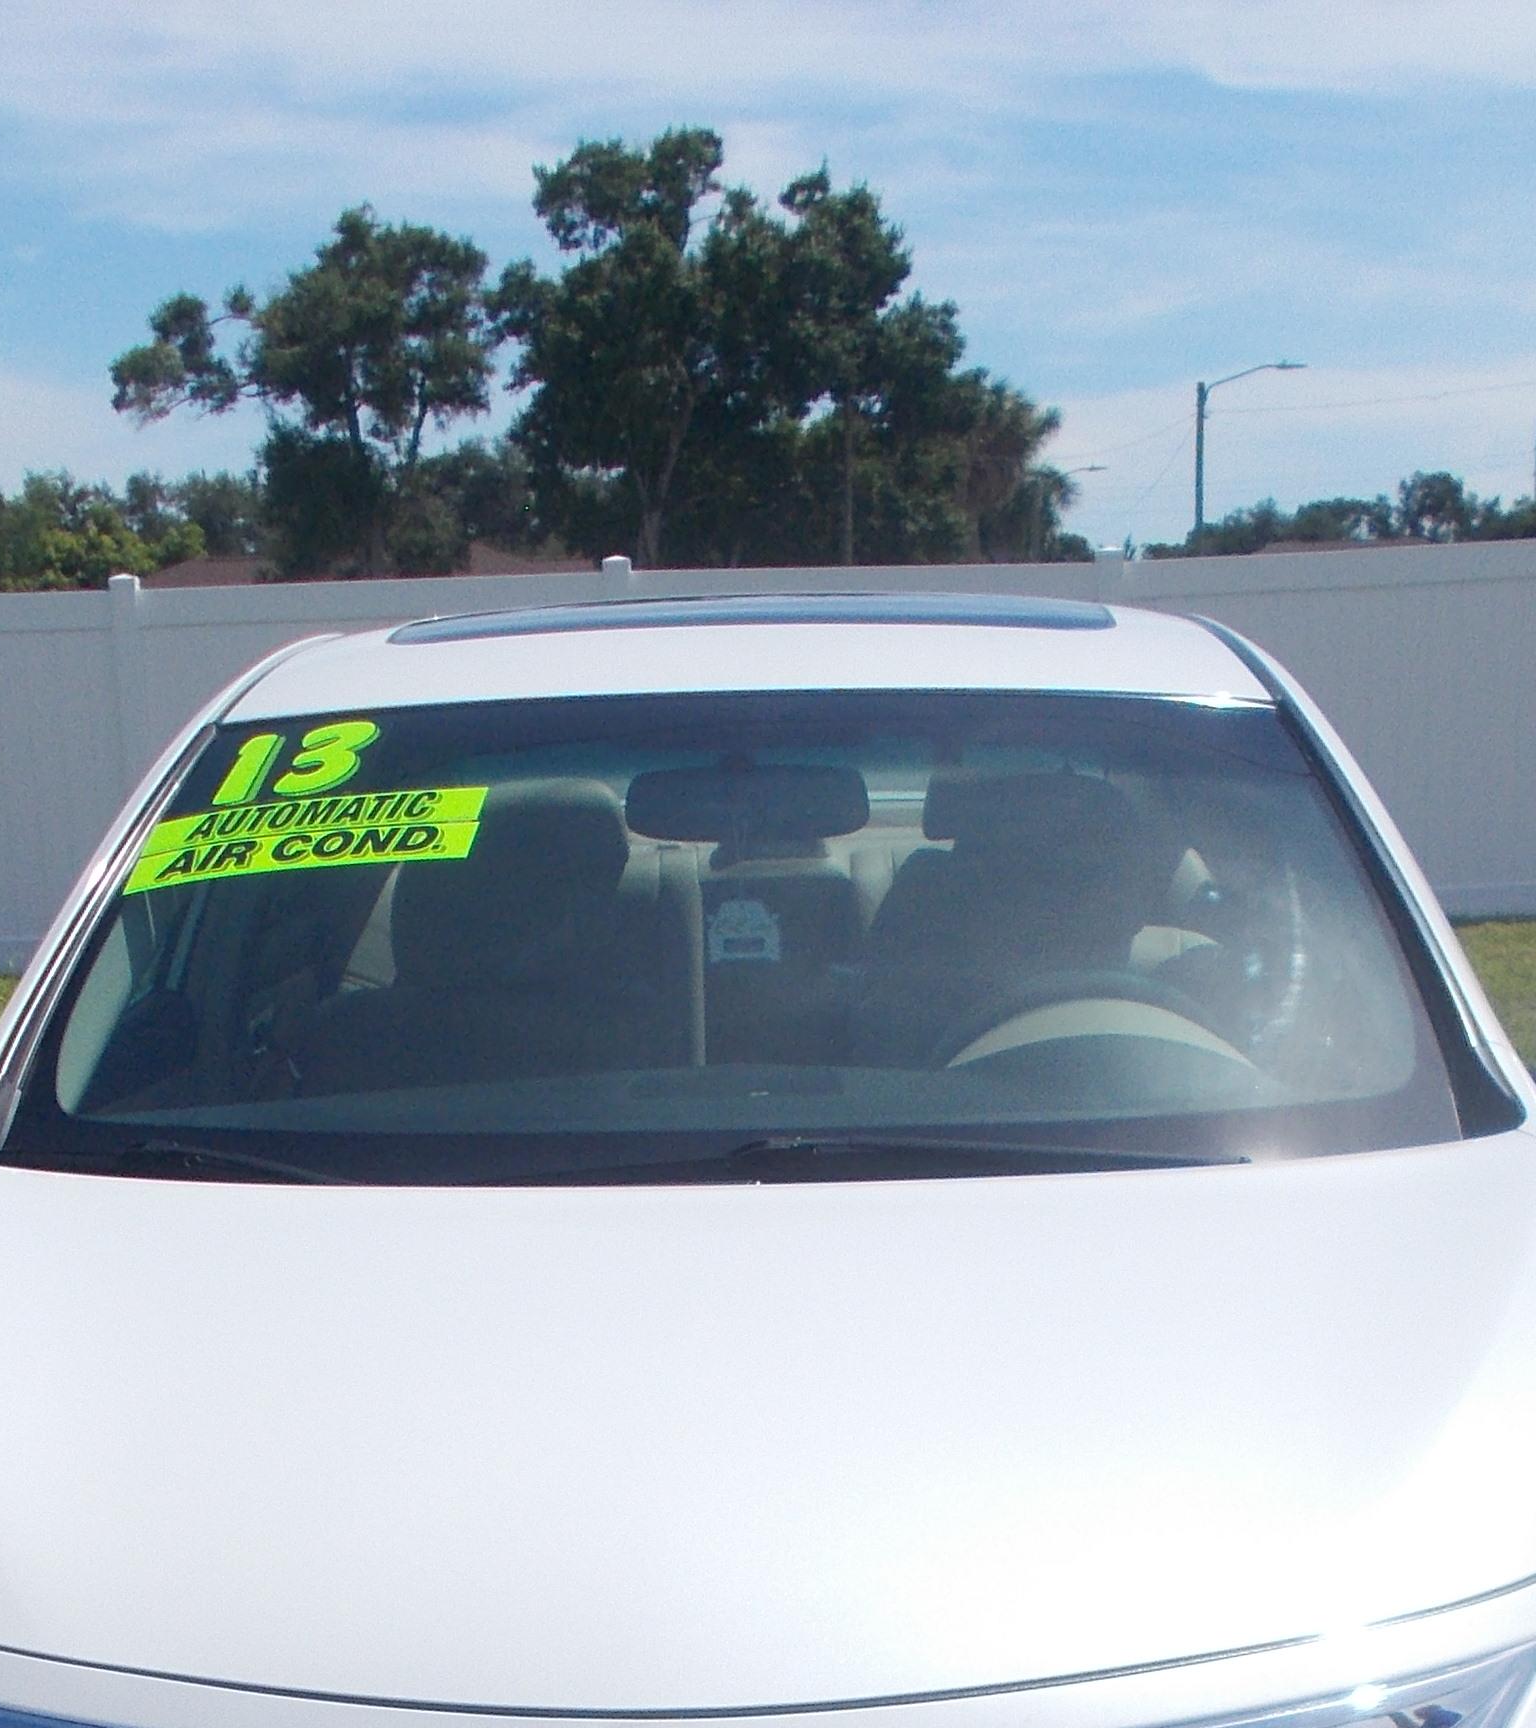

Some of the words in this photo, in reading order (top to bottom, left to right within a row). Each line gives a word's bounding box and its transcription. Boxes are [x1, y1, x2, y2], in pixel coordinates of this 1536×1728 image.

[211, 720, 380, 806] 13
[184, 790, 443, 843] AUTOMATIC
[155, 839, 263, 881] AIR
[270, 825, 445, 862] COND.
